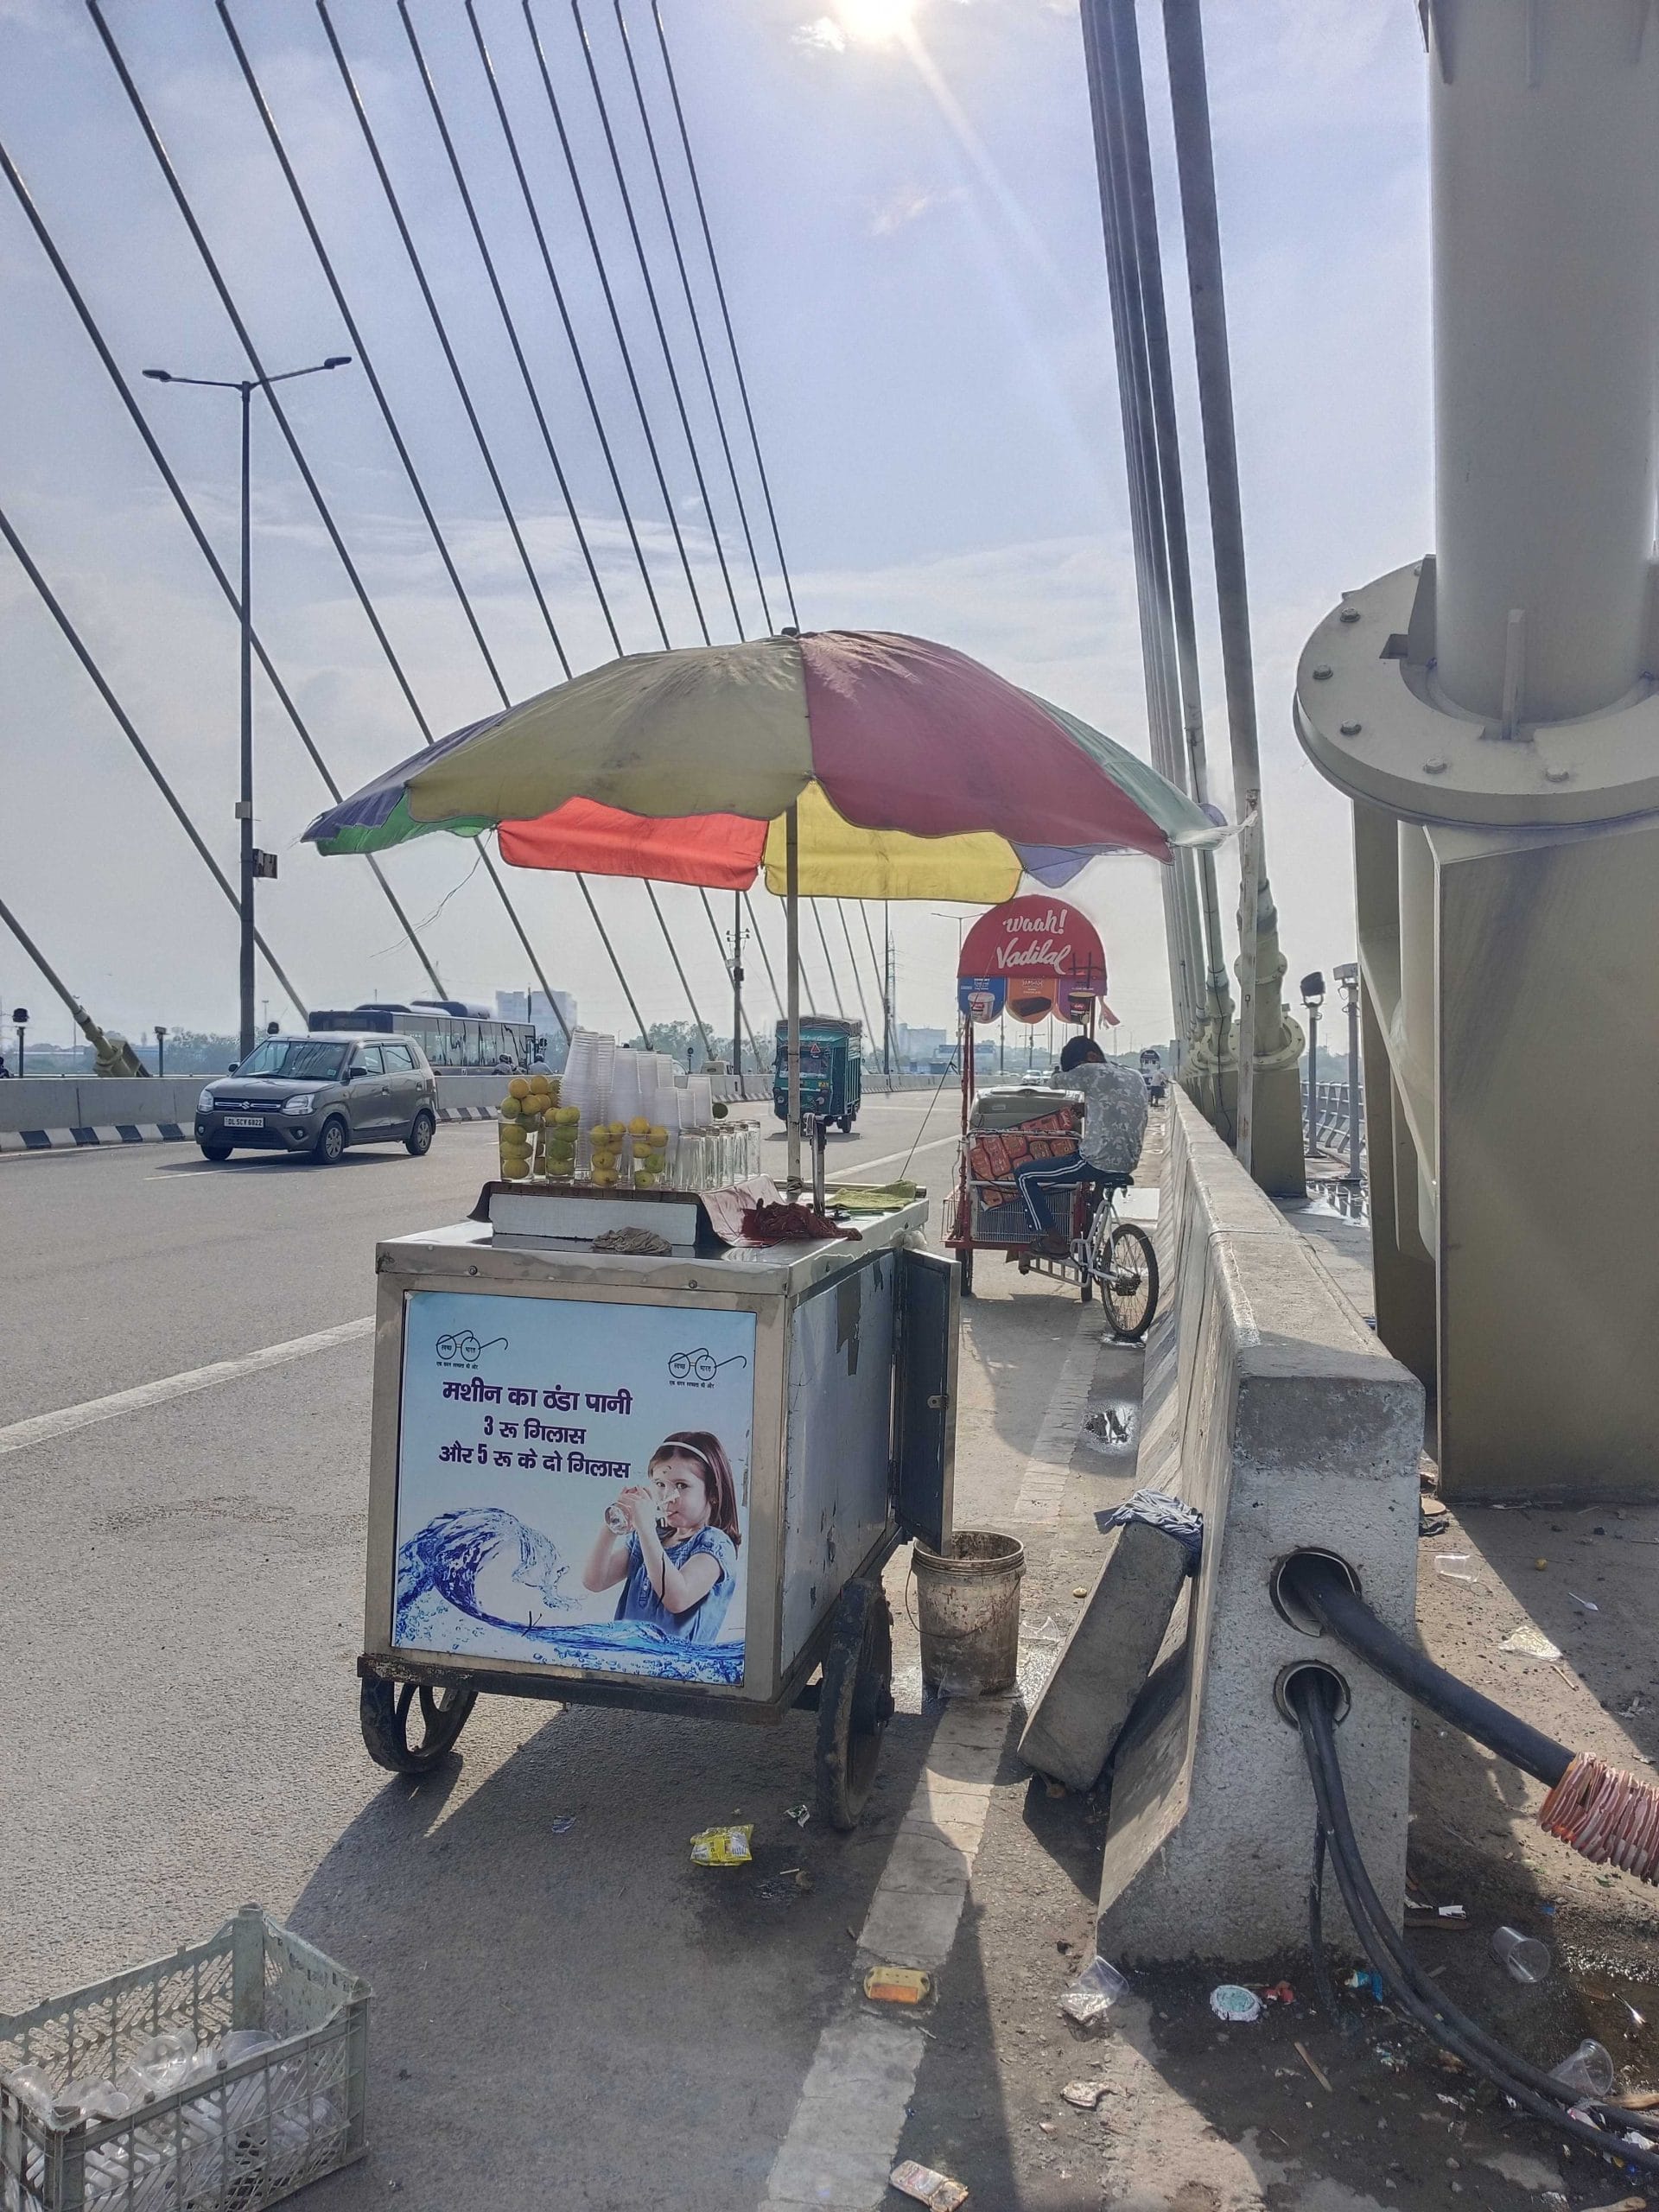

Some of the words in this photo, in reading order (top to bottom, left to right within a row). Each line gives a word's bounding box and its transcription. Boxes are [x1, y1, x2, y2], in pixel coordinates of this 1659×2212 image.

[1003, 909, 1068, 935] waah!
[996, 937, 1072, 976] Vadilal
[442, 1376, 503, 1404] मशीन
[508, 1388, 538, 1407] का
[543, 1384, 580, 1412] ठंडा
[585, 1389, 633, 1414] पानी
[484, 1415, 493, 1435] 3
[499, 1421, 519, 1439] रू
[524, 1417, 587, 1444] गिलास
[439, 1440, 474, 1464] और
[477, 1443, 487, 1465] 5
[493, 1450, 513, 1467] रू
[518, 1447, 537, 1469] के
[543, 1450, 563, 1472] दो
[567, 1451, 632, 1478] गिलास
